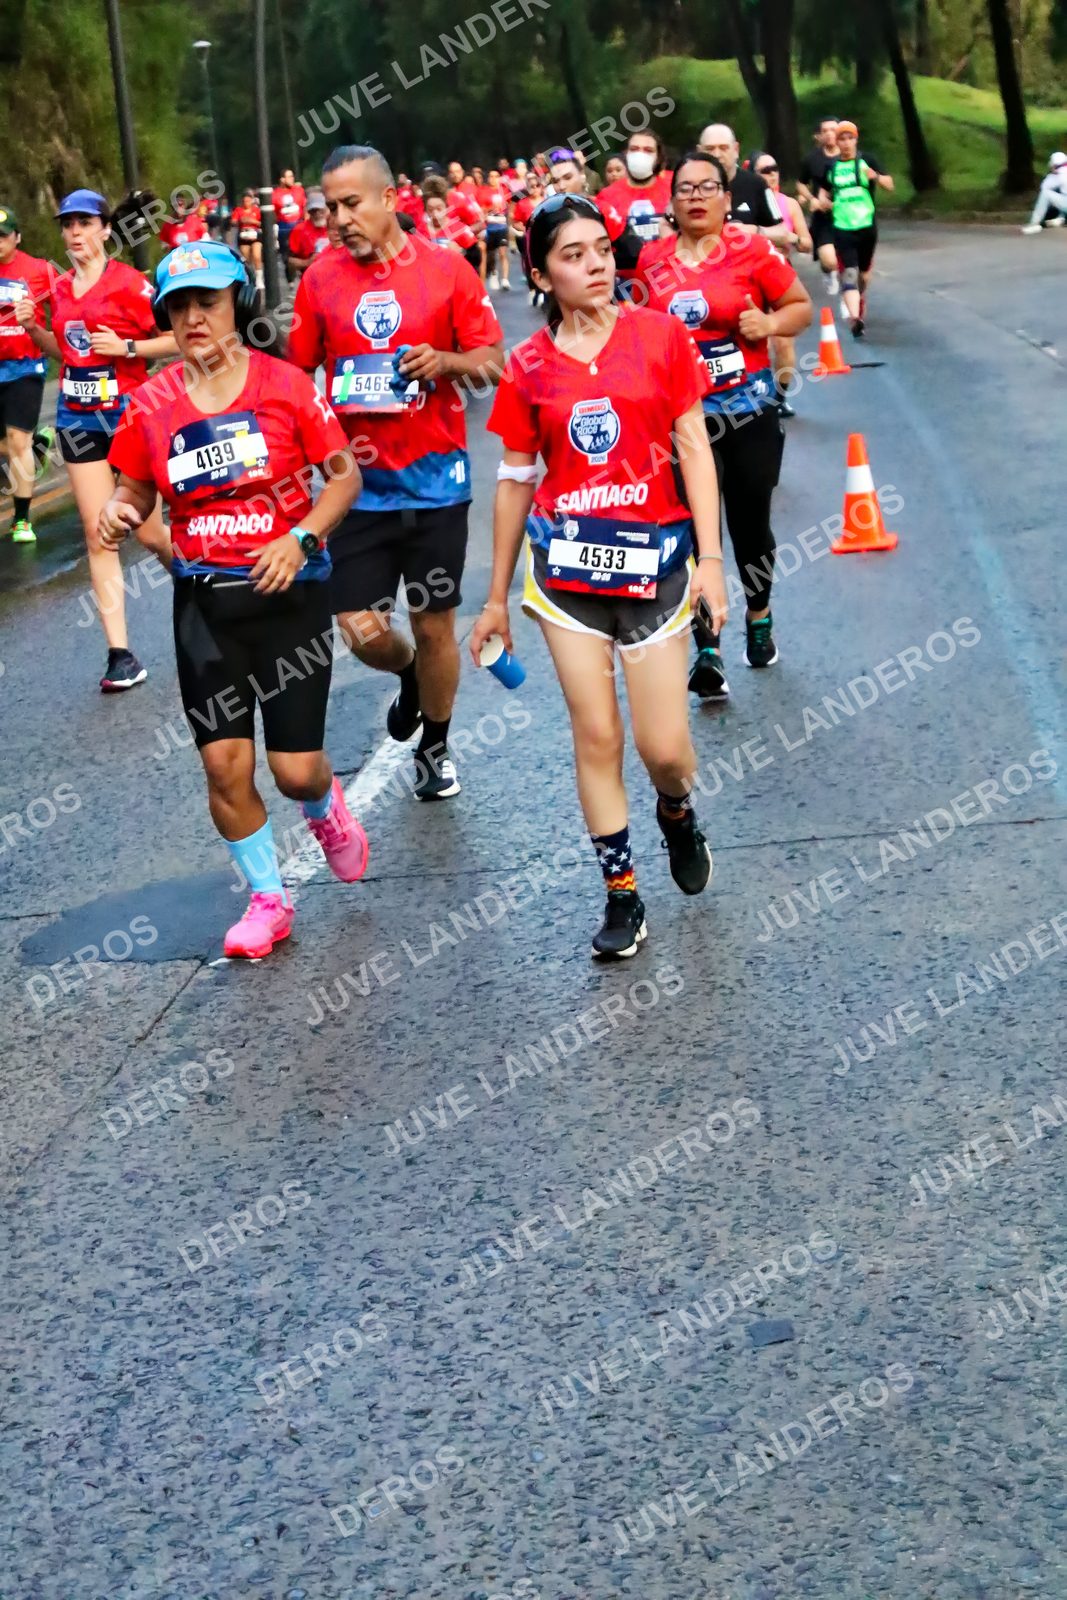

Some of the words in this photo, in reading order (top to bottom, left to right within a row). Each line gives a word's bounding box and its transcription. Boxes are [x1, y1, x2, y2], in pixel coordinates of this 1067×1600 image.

[73, 382, 97, 395] 5122
[578, 404, 606, 414] BIMBO
[581, 414, 607, 427] Global
[577, 425, 598, 436] Race
[196, 442, 236, 470] 4139
[555, 483, 649, 511] SANTIAGO
[187, 514, 273, 536] SANTIAGO
[579, 545, 627, 570] 4533
